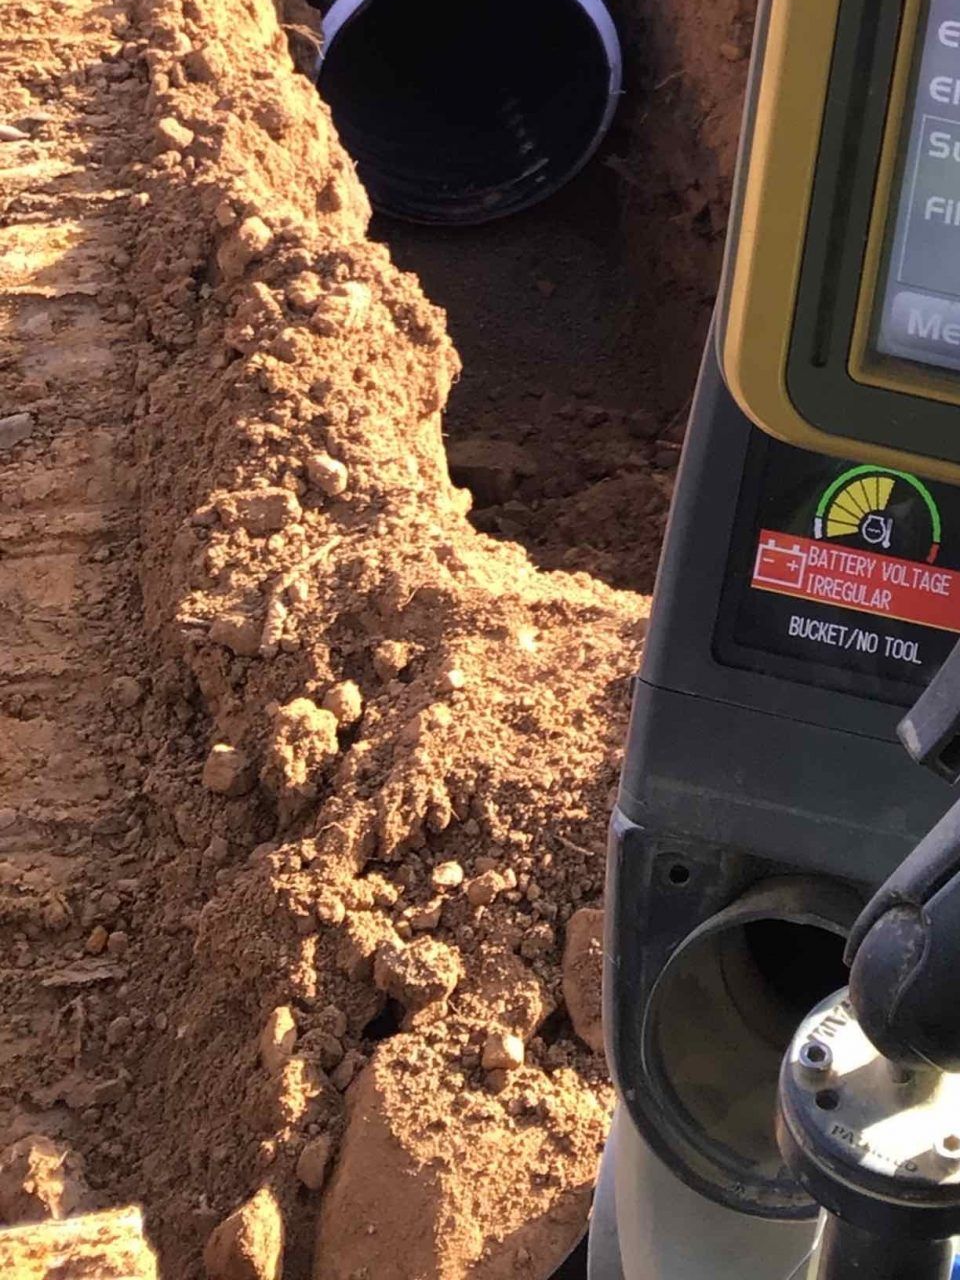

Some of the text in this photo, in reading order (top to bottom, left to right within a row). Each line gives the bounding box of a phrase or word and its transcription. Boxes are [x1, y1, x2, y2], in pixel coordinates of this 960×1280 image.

[806, 546, 953, 596] BATTERY VOLTAGE
[806, 573, 893, 611] IRREGULAR
[788, 615, 923, 664] BUCKET/NO TOOL
